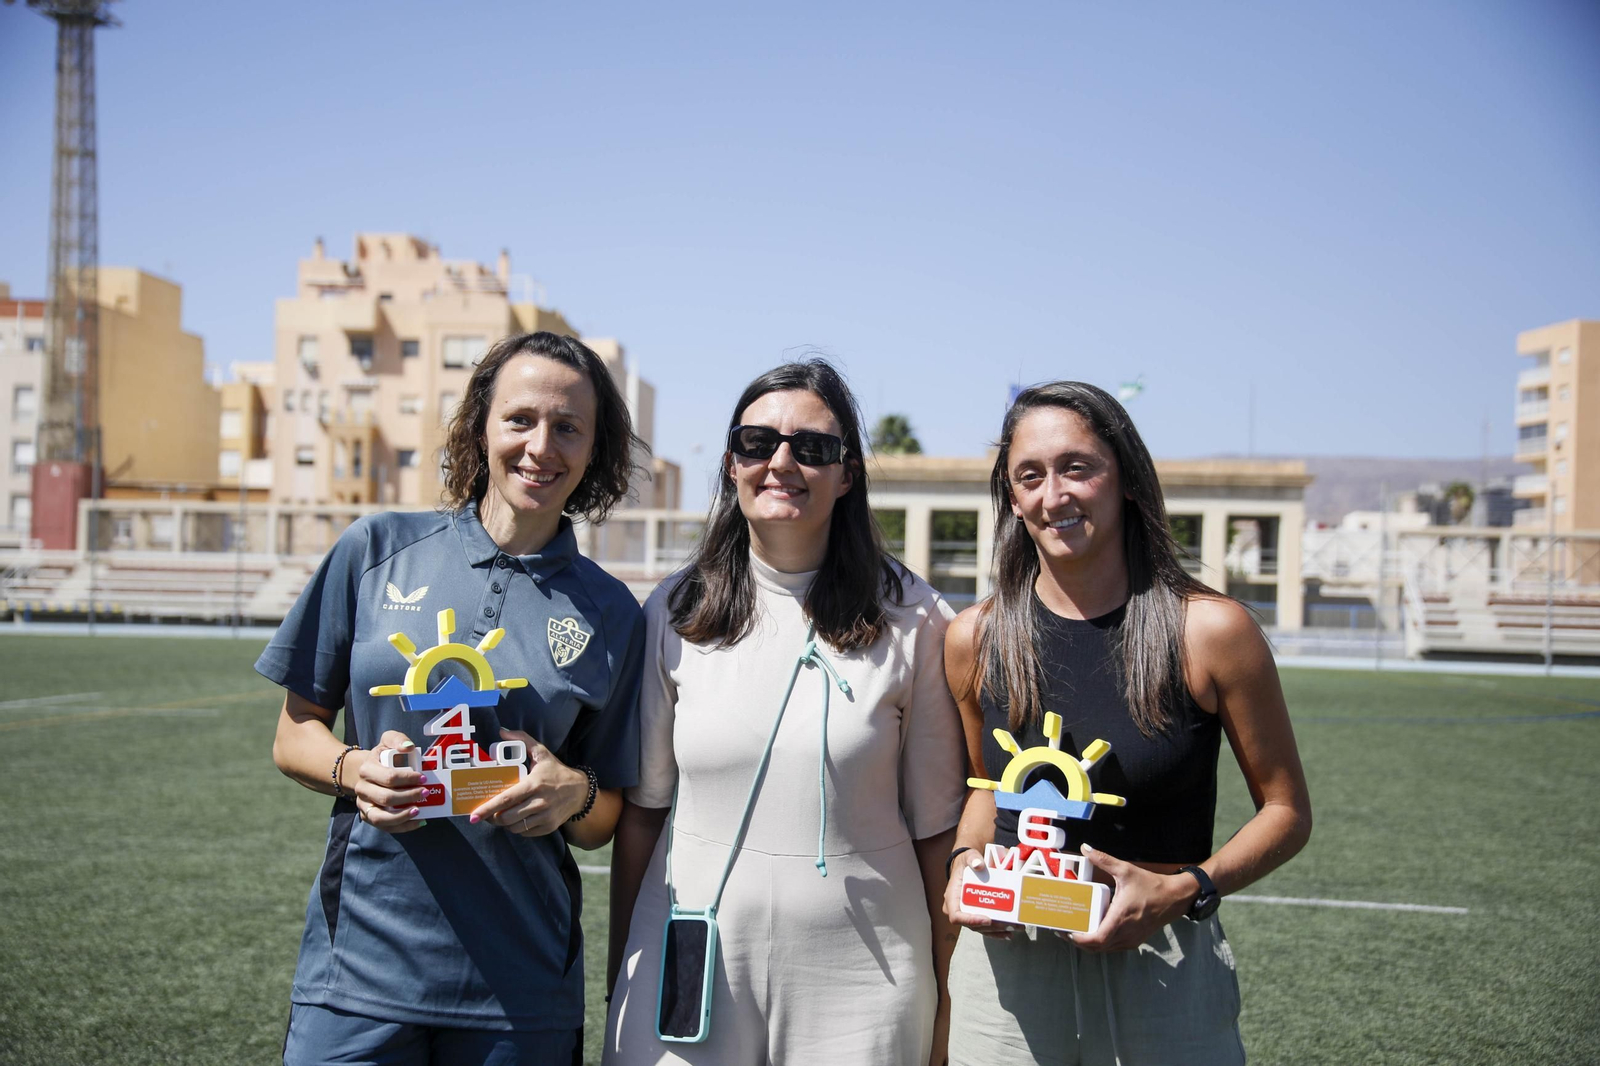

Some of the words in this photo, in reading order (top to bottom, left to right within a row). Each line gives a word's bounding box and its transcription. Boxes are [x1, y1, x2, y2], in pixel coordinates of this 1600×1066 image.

[382, 603, 422, 612] CASTORE
[552, 622, 562, 631] U
[574, 631, 584, 640] D
[427, 703, 476, 741] 4
[382, 740, 527, 772] CHELO
[1017, 807, 1062, 849] 6
[984, 843, 1090, 882] MATI
[965, 887, 1011, 900] FUNDACIÓN
[978, 896, 996, 905] UDA
